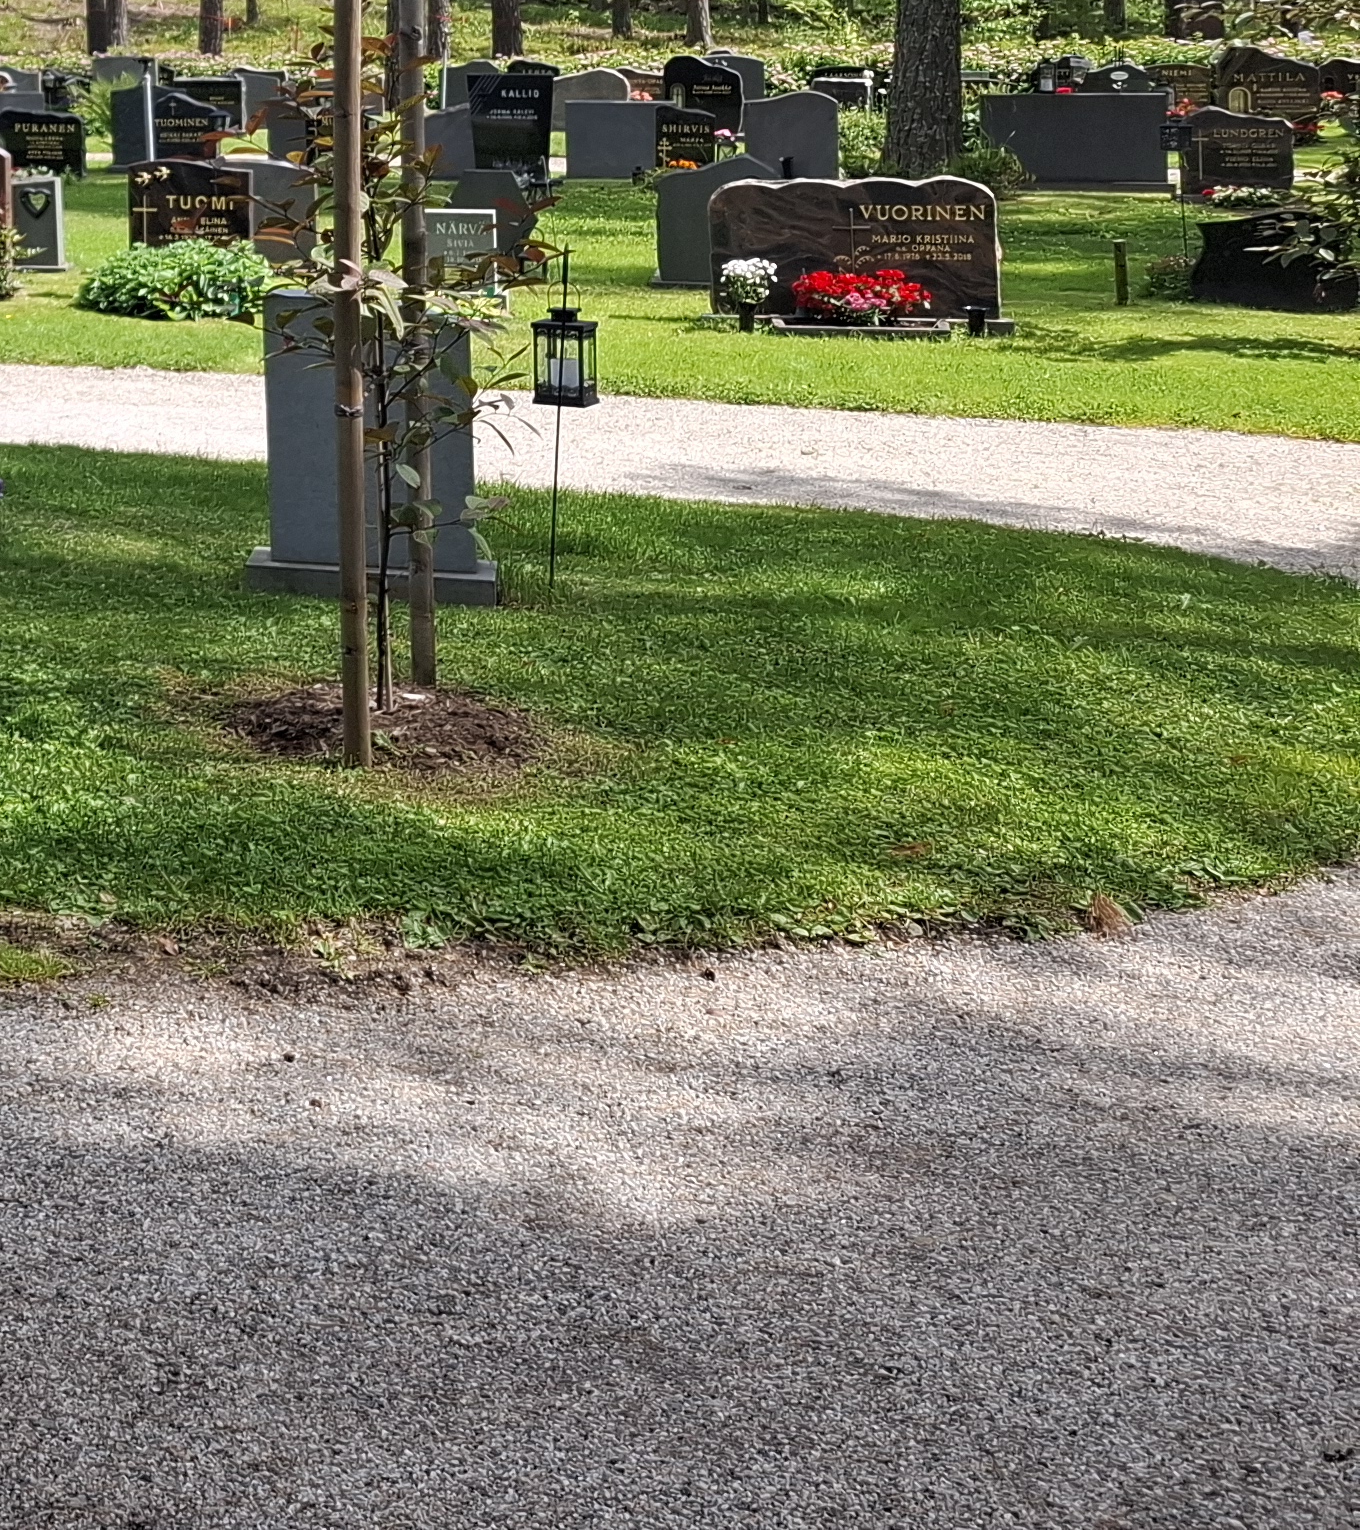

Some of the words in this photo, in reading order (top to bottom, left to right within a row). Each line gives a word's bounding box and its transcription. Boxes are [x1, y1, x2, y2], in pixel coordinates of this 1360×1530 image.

[1233, 73, 1306, 82] MATTILA
[501, 89, 540, 98] KALLIO
[154, 118, 209, 127] TUOMINEN
[14, 123, 76, 133] PURANEN
[1213, 129, 1284, 138] LUNDGREN
[165, 195, 234, 210] TUOMI
[859, 205, 986, 221] VUORINEN
[872, 235, 911, 244] MARJO
[916, 235, 975, 244] KRISTIINA
